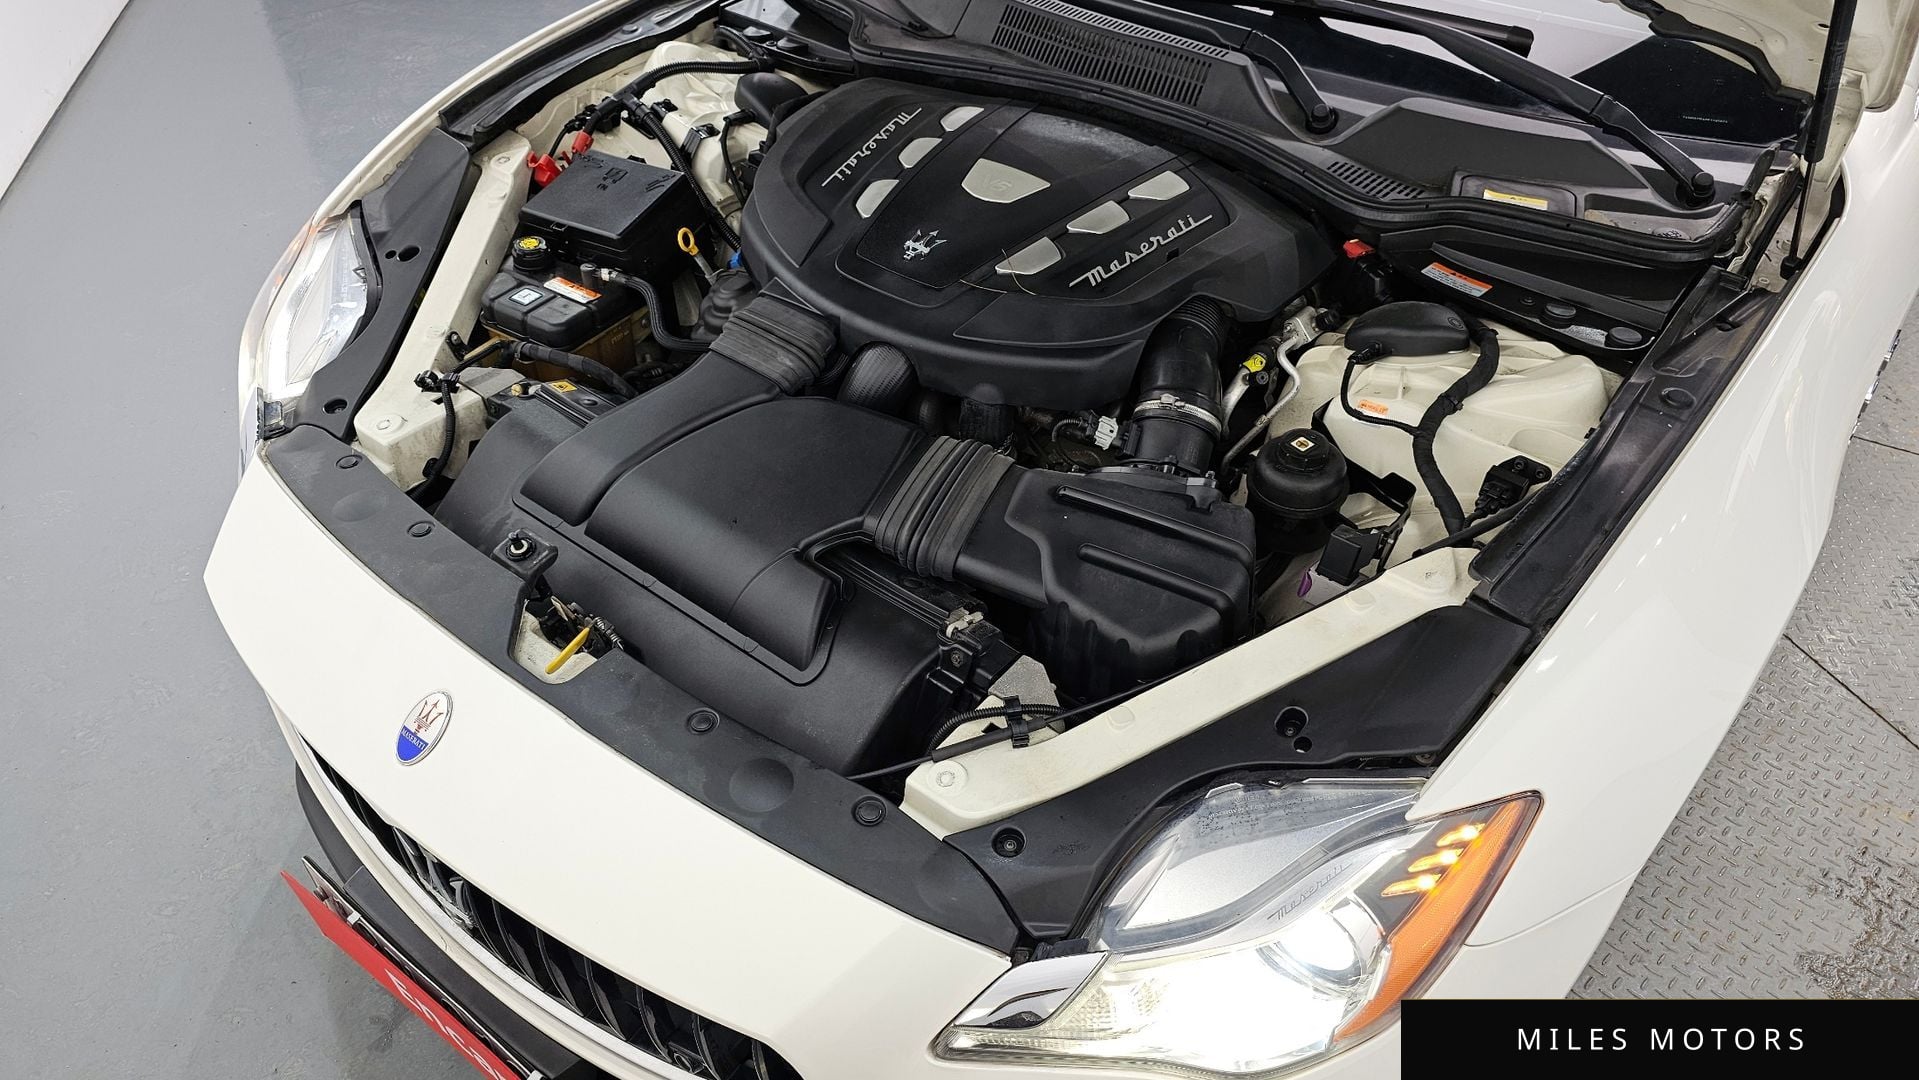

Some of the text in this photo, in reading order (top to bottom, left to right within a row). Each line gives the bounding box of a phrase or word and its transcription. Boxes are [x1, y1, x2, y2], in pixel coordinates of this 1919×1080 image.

[821, 107, 922, 187] Maserati
[1069, 214, 1213, 287] Maserati
[401, 728, 426, 750] MASERATI
